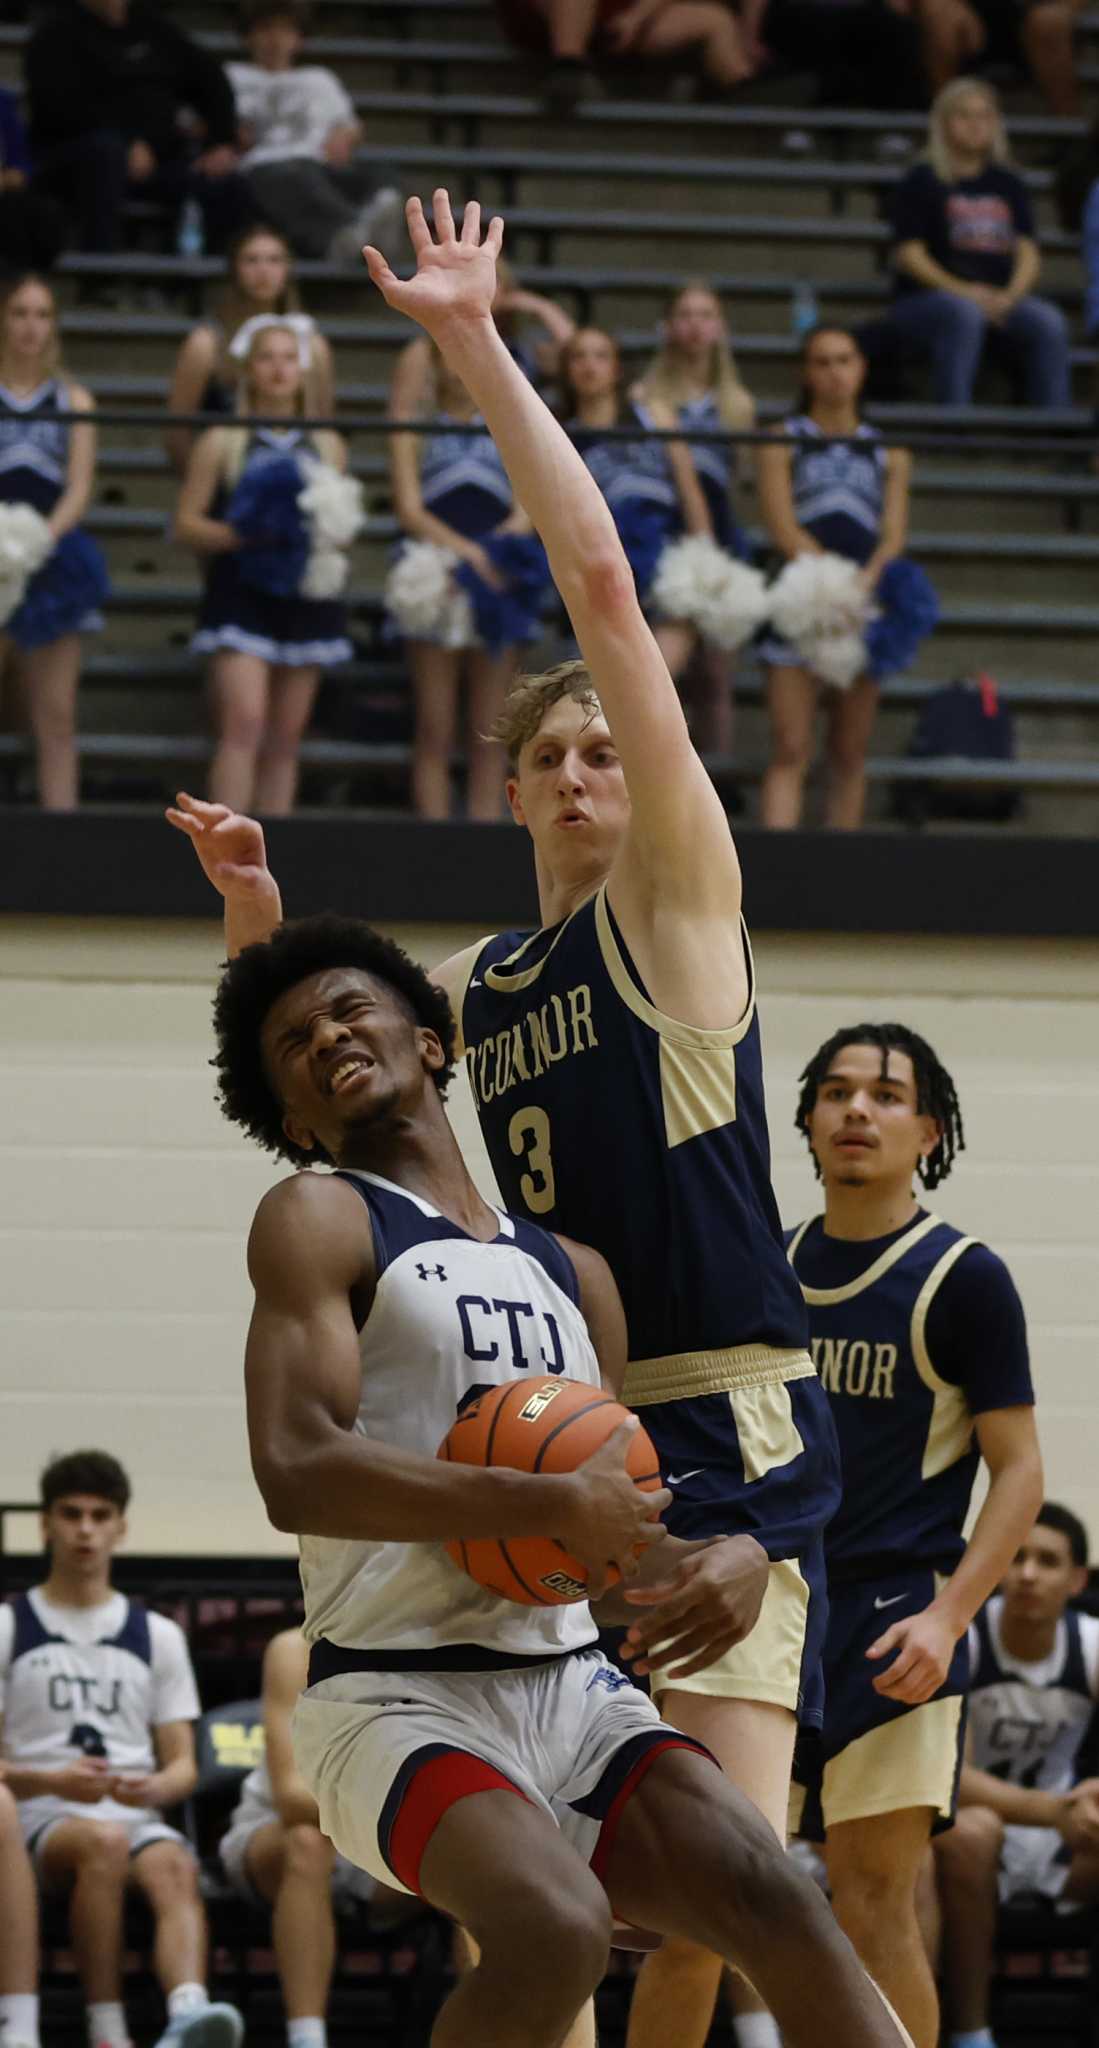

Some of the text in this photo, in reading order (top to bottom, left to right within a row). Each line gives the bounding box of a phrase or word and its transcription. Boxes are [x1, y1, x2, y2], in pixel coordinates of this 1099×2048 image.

[508, 1106, 555, 1214] 3
[456, 1295, 565, 1375] CTJ
[49, 1674, 122, 1717] CTJ
